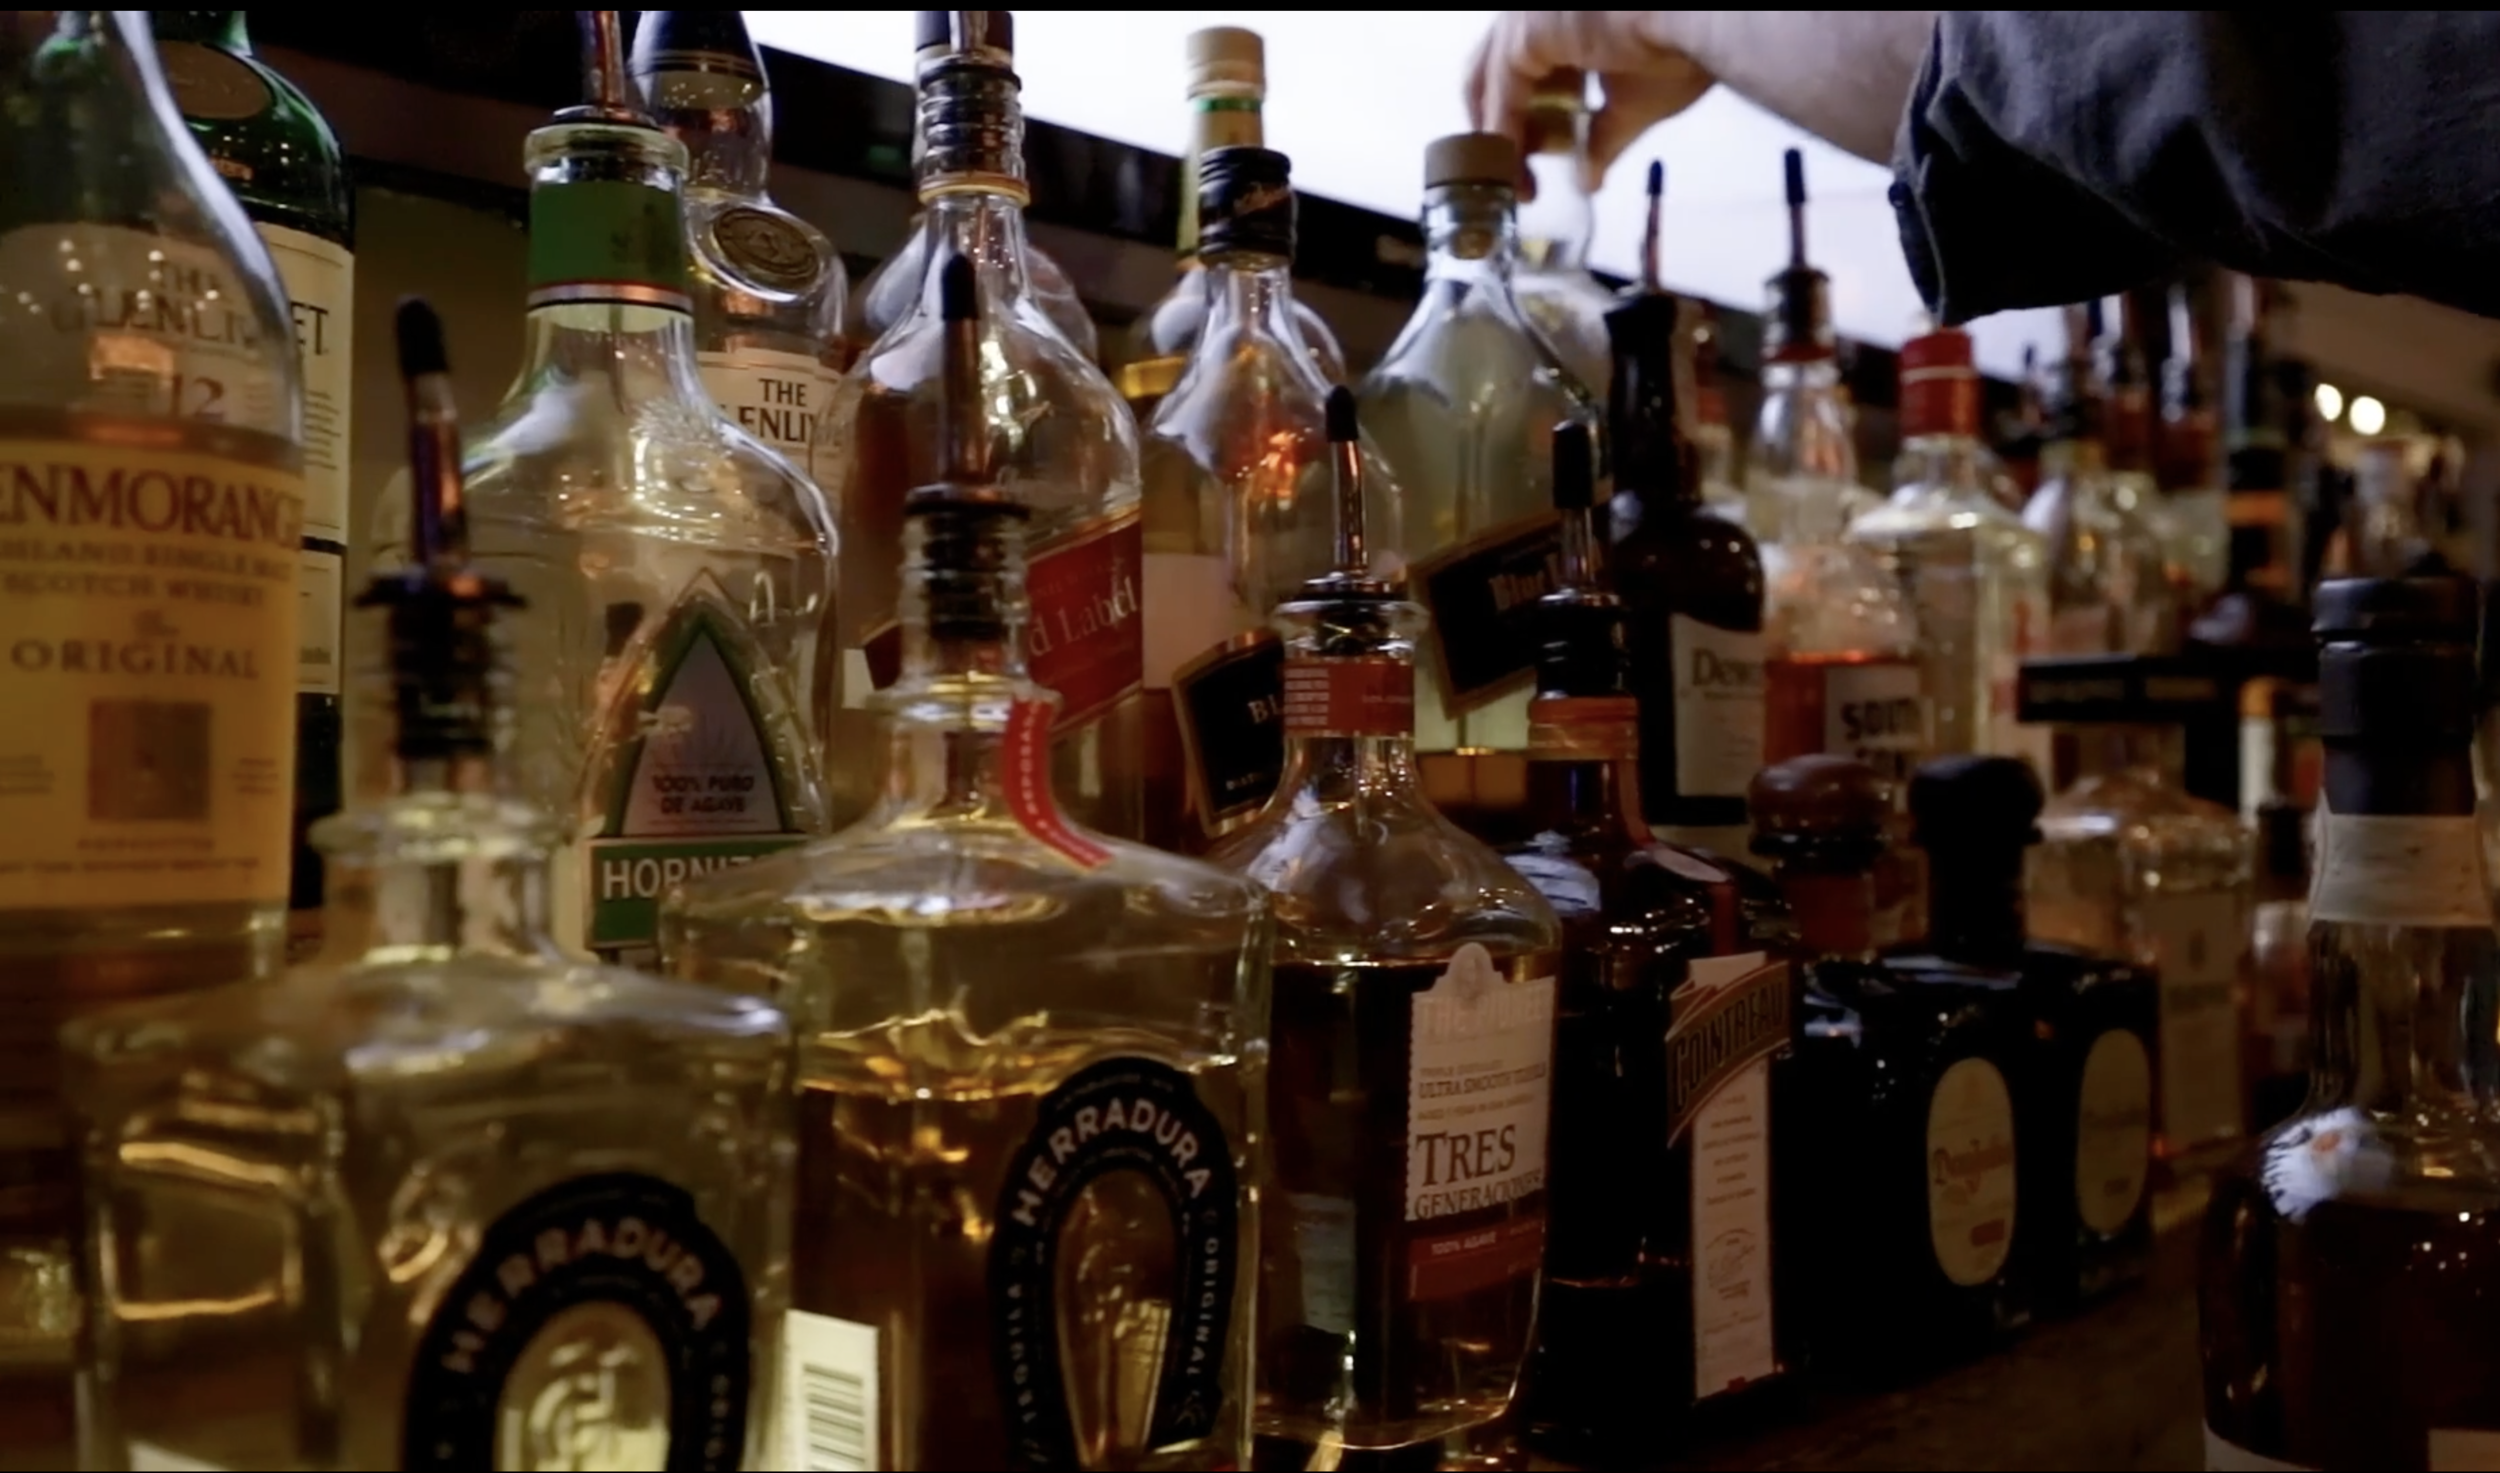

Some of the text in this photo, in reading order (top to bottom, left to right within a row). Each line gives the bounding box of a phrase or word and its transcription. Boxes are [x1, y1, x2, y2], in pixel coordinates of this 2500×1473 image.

[757, 377, 808, 408] THE
[10, 637, 261, 682] ORIGINAL
[661, 795, 745, 814] DE AGAVE
[708, 775, 755, 792] PURO
[1674, 982, 1784, 1114] COINTREAU
[1012, 1097, 1213, 1228] HERRADURA
[1415, 1122, 1516, 1188] TRES
[1185, 1236, 1220, 1376] ORIGINAL
